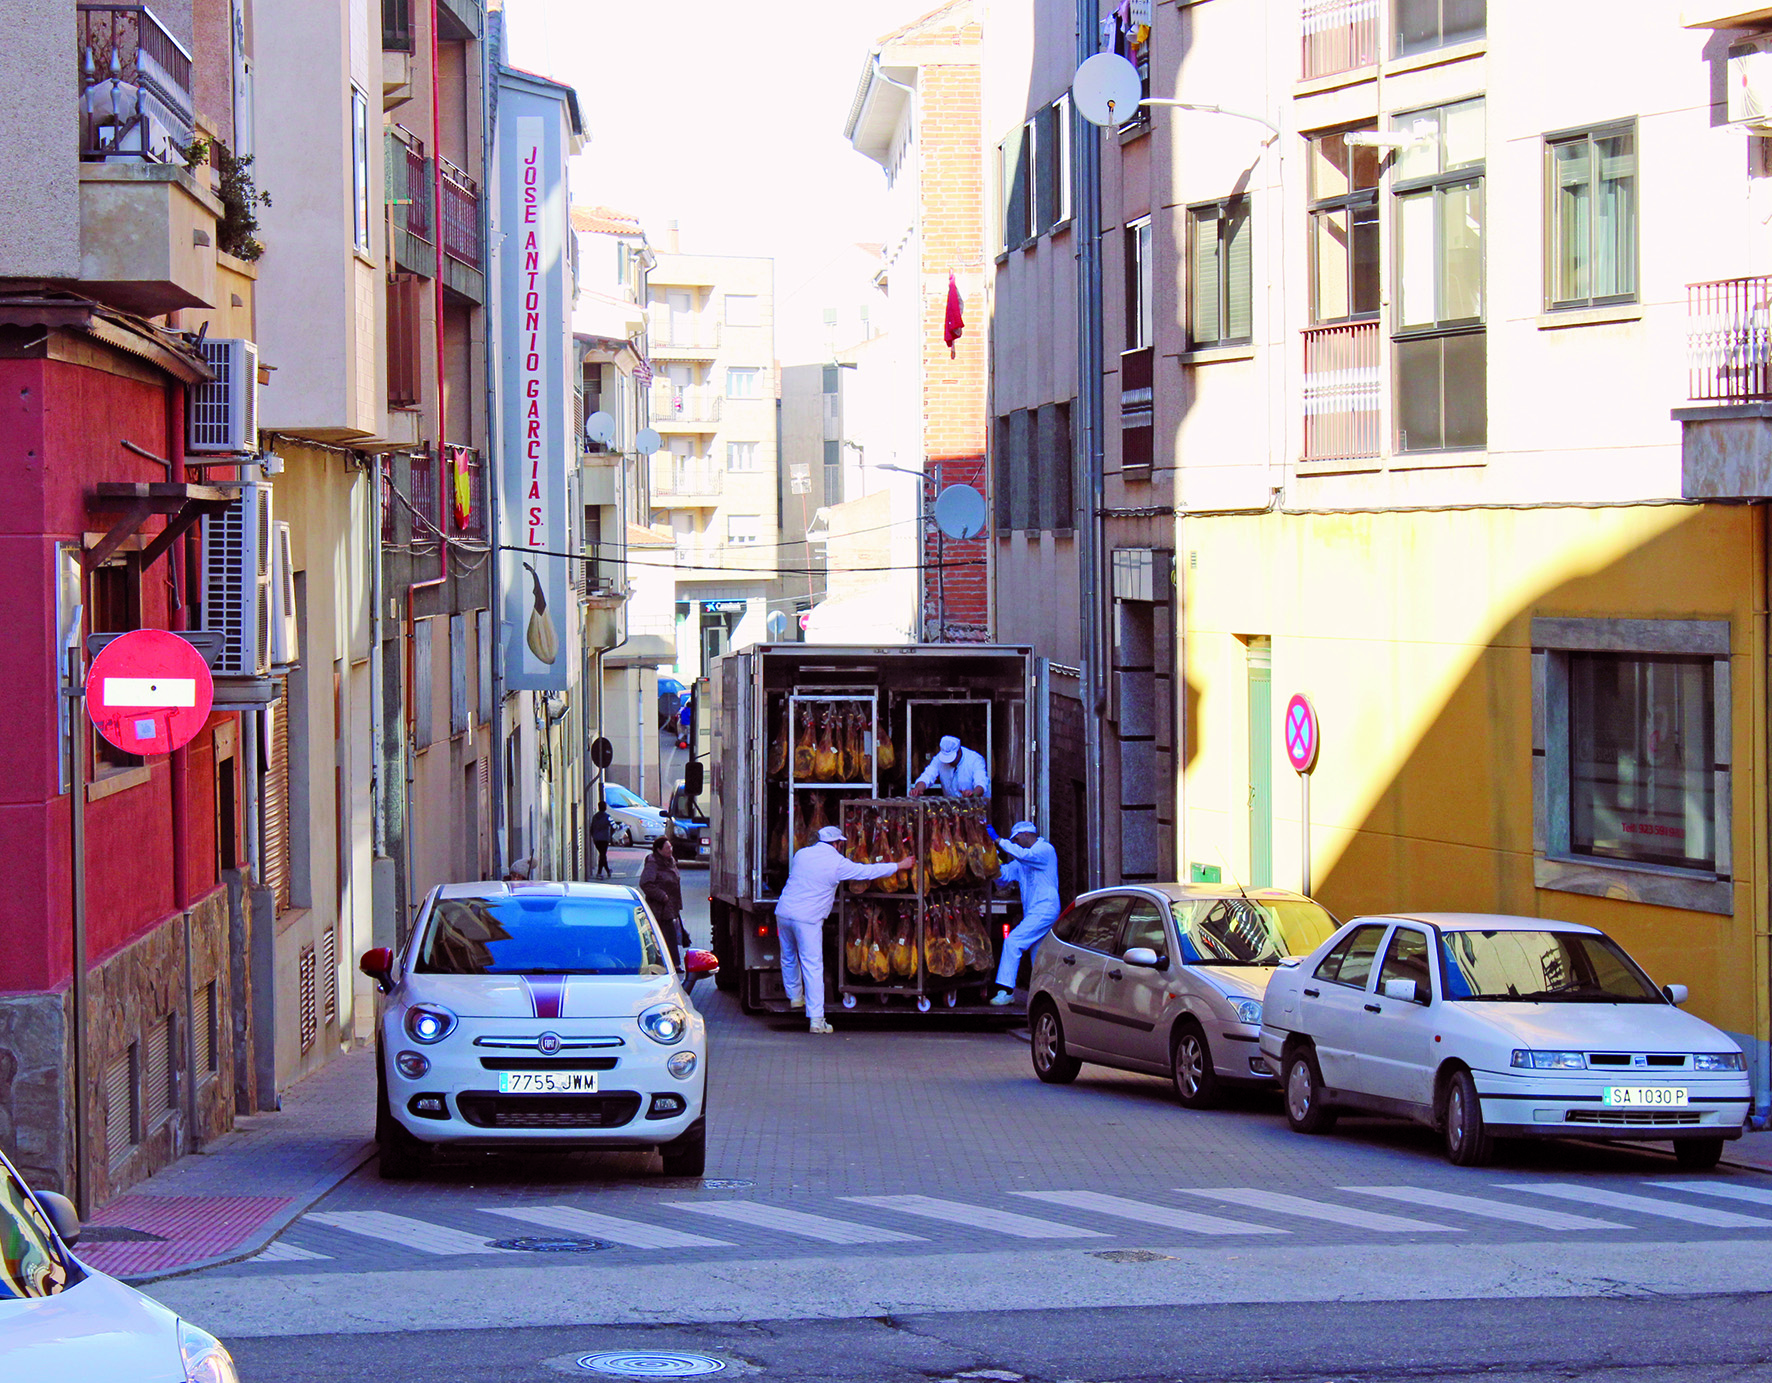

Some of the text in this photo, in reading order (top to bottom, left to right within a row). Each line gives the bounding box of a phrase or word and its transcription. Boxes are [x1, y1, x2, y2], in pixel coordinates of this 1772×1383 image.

[524, 146, 538, 224] JOSE
[525, 231, 540, 372] ANTONIO
[526, 379, 541, 499] GARCIA
[512, 1074, 594, 1090] 7755 JWM
[1614, 1089, 1684, 1104] SA 1030 P
